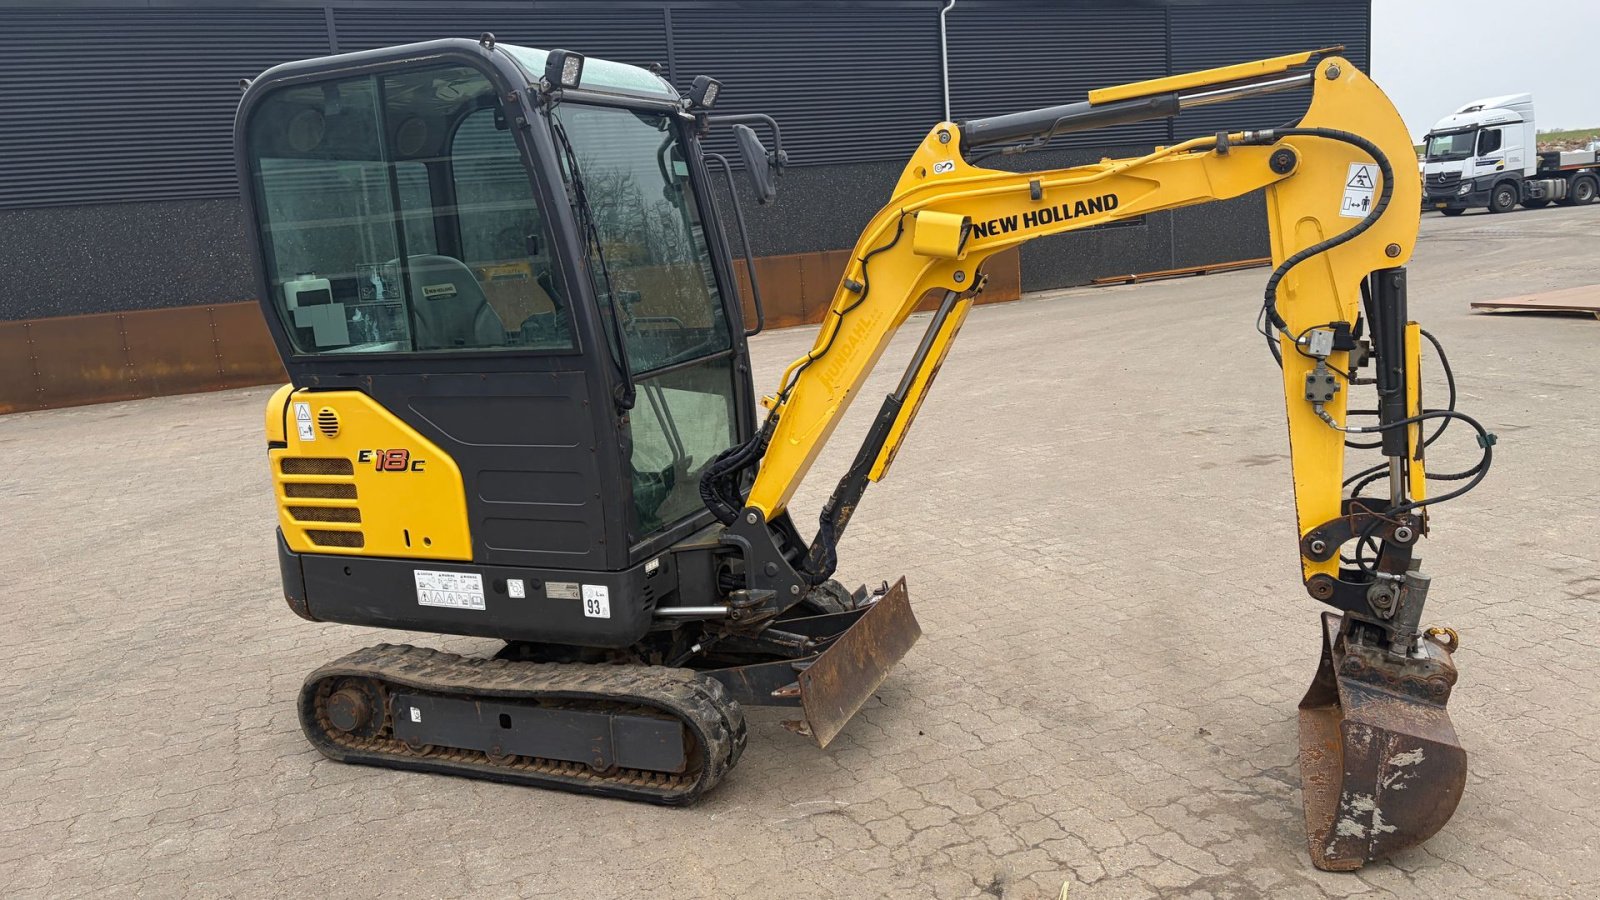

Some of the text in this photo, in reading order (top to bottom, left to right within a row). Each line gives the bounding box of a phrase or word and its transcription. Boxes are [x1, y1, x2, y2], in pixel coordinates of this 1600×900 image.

[973, 193, 1119, 239] NEW HOLLAND
[587, 598, 601, 615] 93
